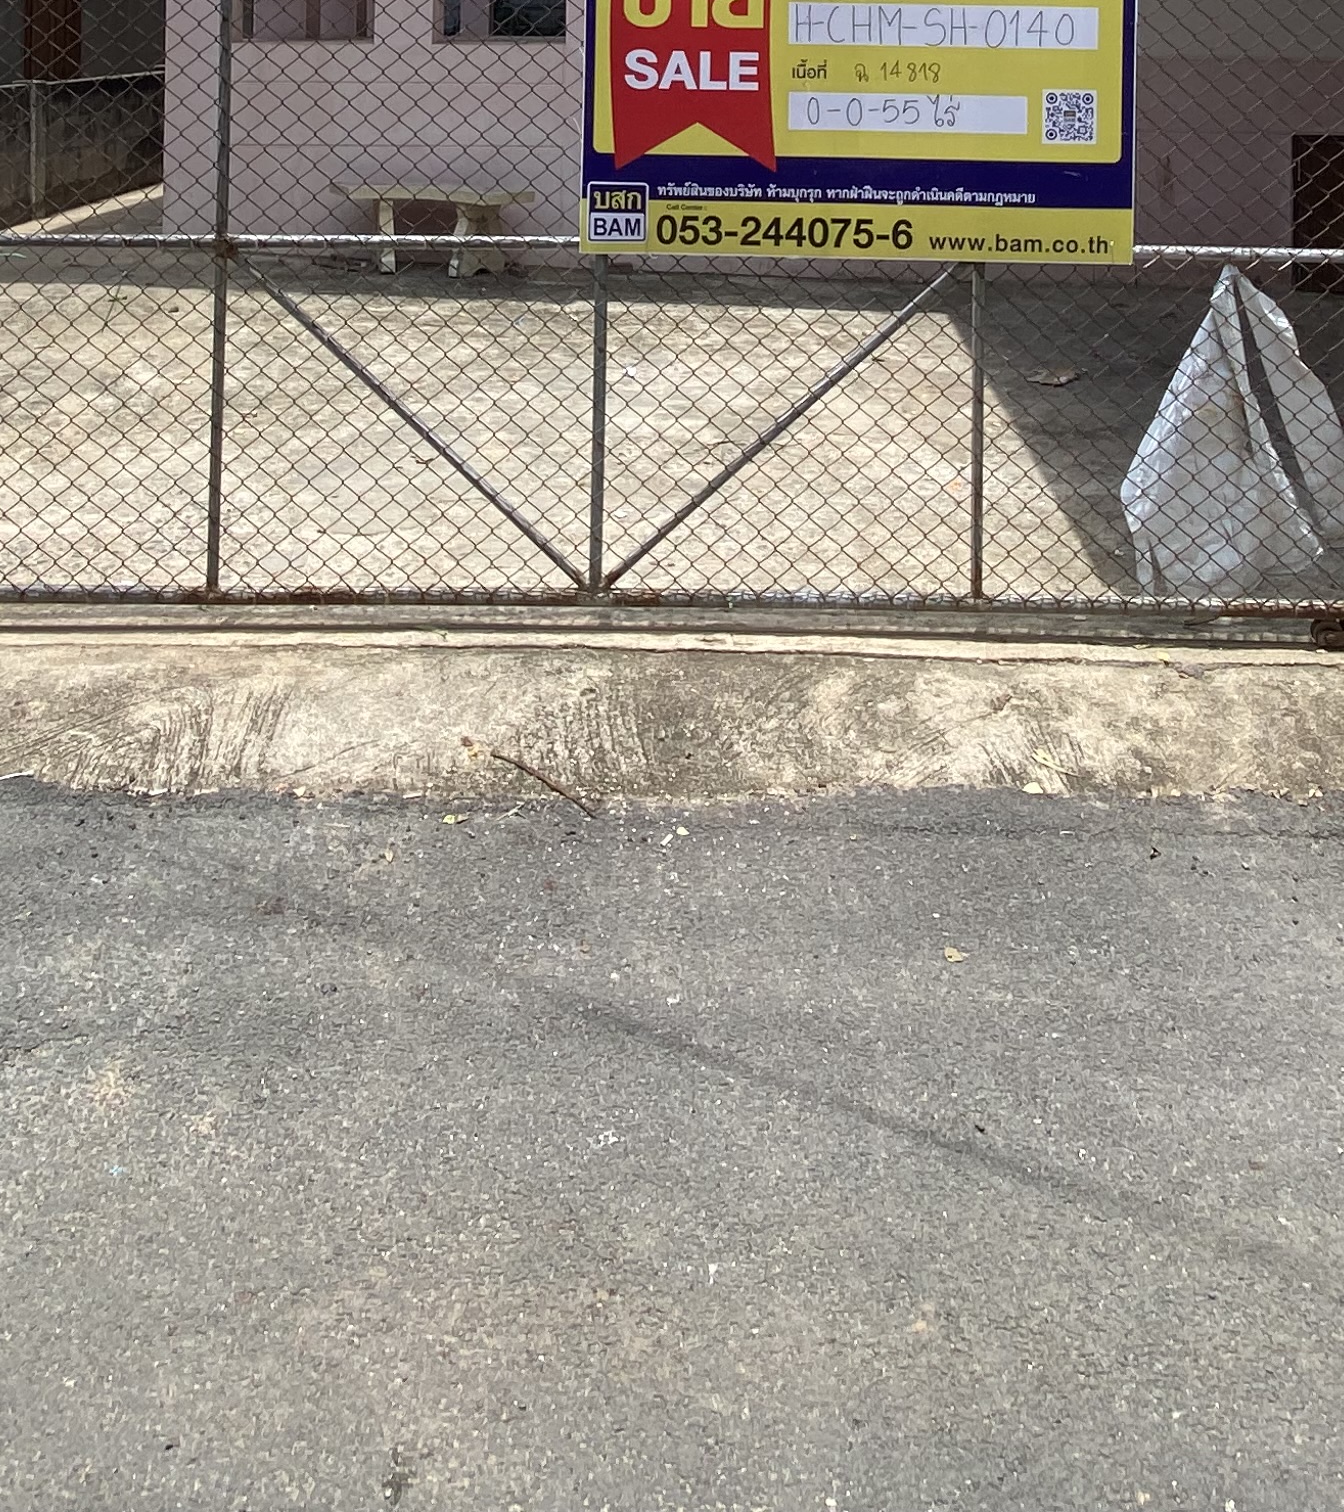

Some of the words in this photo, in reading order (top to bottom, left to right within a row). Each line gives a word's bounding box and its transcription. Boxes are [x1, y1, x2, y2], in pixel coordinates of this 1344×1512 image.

[794, 3, 1075, 49] H-CHM-SH-0140
[623, 48, 760, 91] SALE
[791, 58, 828, 80] เนื้อที่
[806, 96, 921, 127] 0-0-55
[592, 189, 643, 211] บสก
[657, 181, 763, 198] ทรัพย์สินของบริษัท
[766, 183, 823, 204] ห้ามบุกรุก
[826, 184, 1037, 207] หากฝ่าฝืนจะถูกดำเนินคดีตามกฎหมาย
[592, 217, 641, 237] BAM
[656, 214, 914, 250] 053-244075-6
[928, 233, 1109, 255] www.bam.co.th
